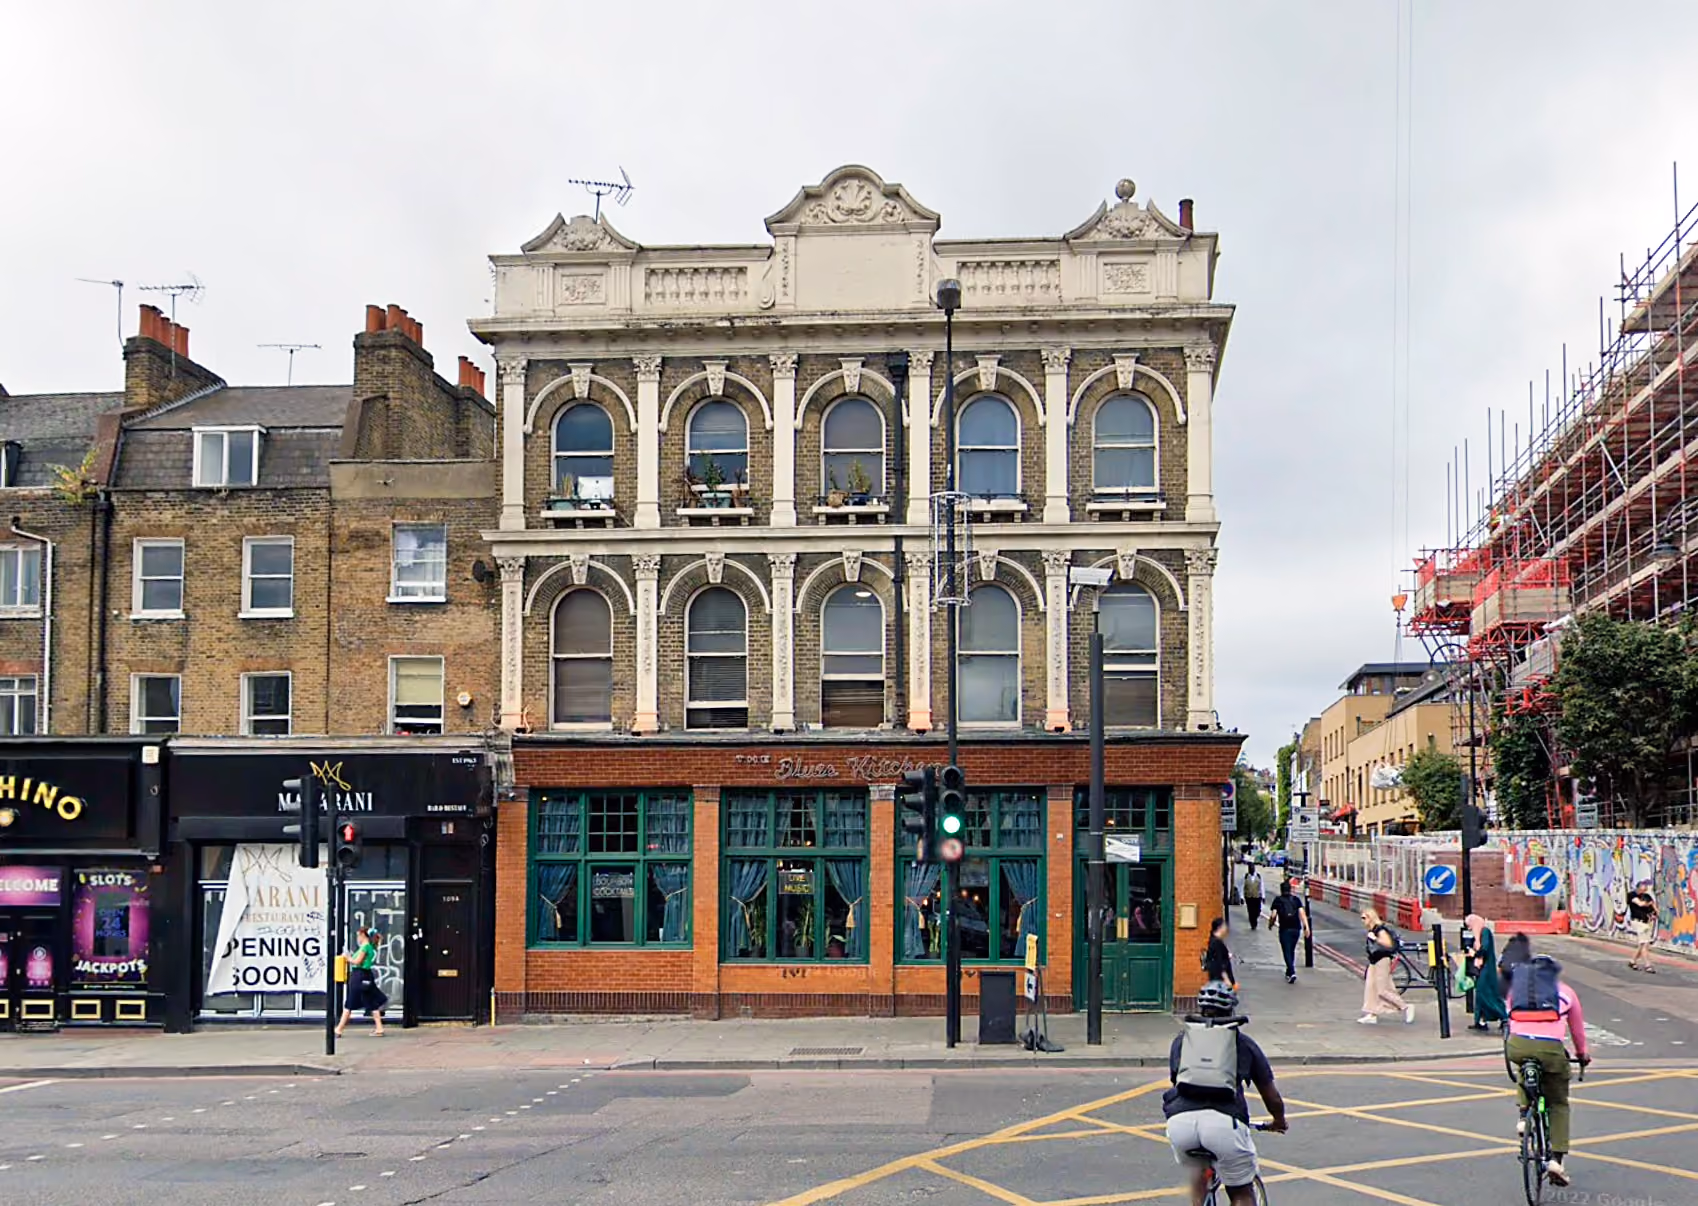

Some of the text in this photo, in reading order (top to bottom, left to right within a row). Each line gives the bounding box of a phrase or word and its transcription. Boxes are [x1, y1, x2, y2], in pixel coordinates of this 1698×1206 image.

[774, 755, 839, 780] Blues
[0, 776, 82, 820] HINO
[278, 792, 373, 811] MAARANI
[90, 874, 132, 886] SLOTS
[75, 960, 146, 974] JACKPOTS
